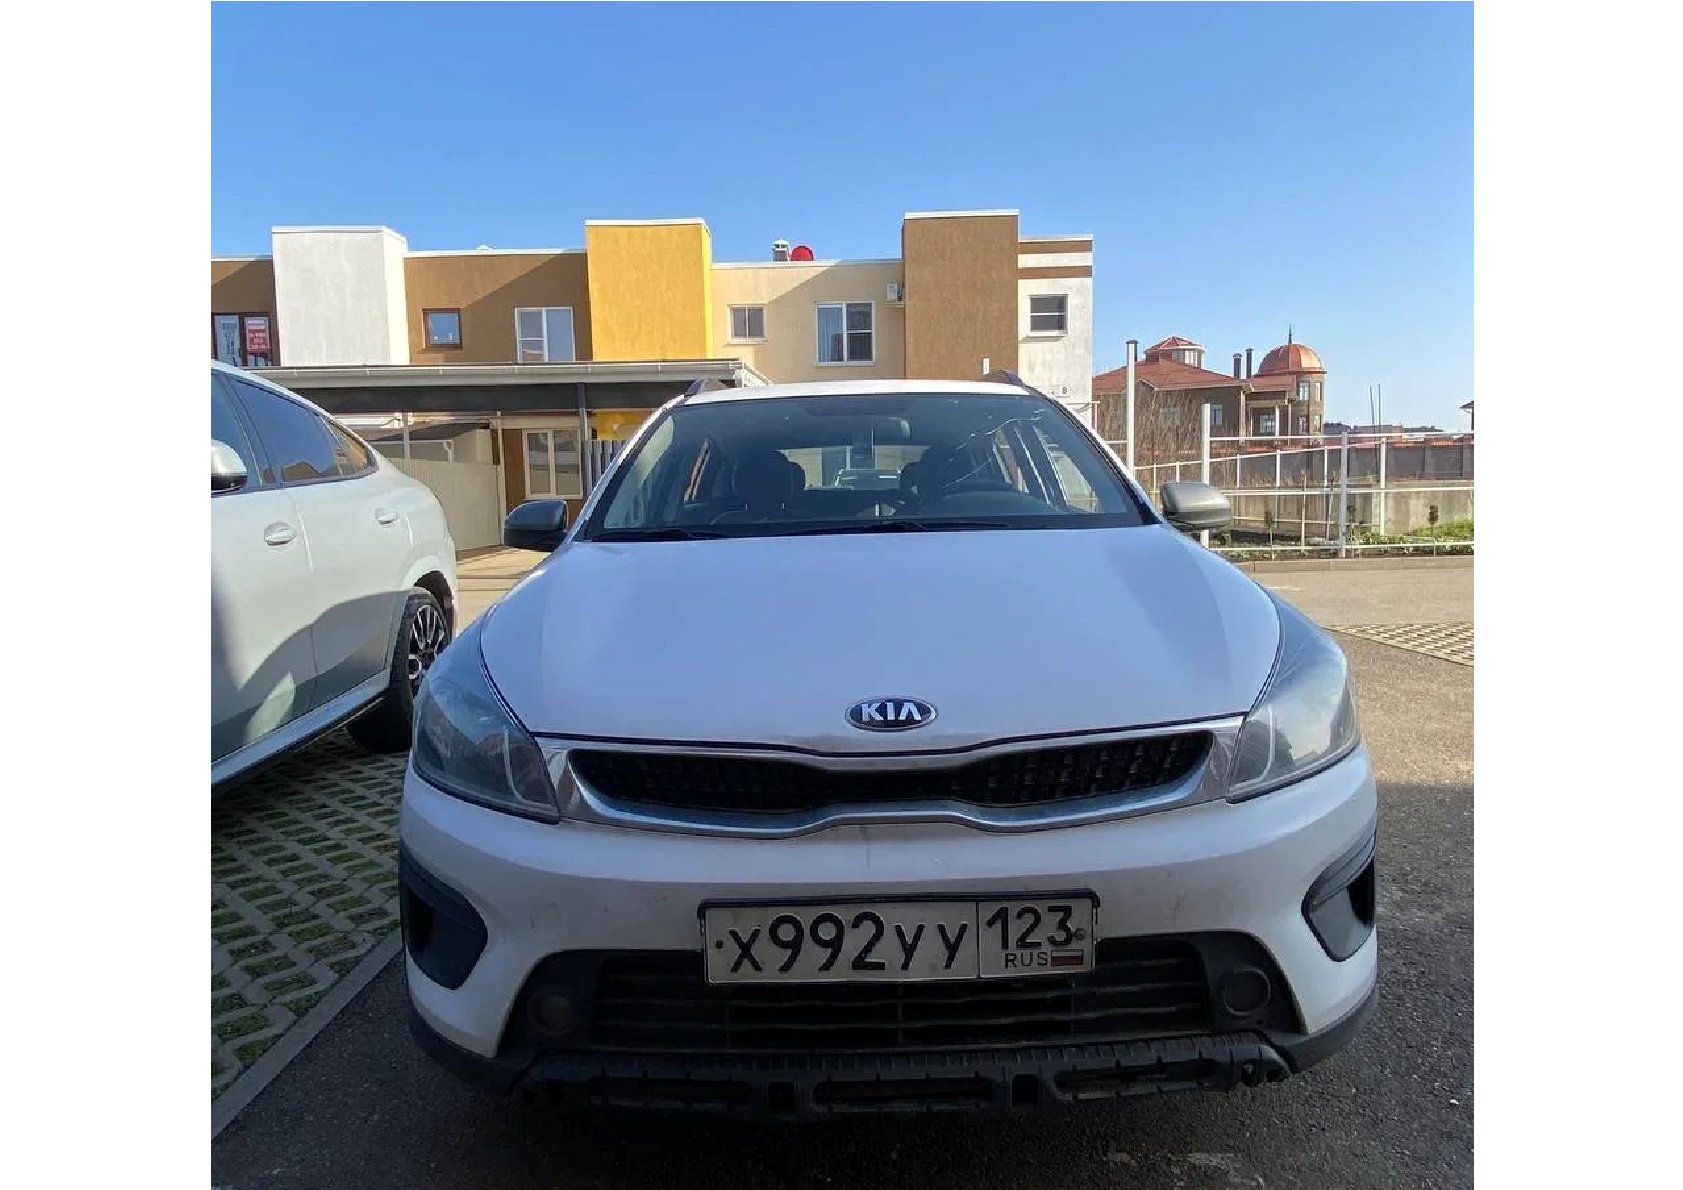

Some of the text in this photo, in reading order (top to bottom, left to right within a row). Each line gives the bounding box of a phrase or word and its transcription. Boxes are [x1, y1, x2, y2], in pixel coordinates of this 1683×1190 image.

[861, 702, 922, 721] KIA
[985, 905, 1073, 950] 123
[1004, 951, 1048, 969] RUS
